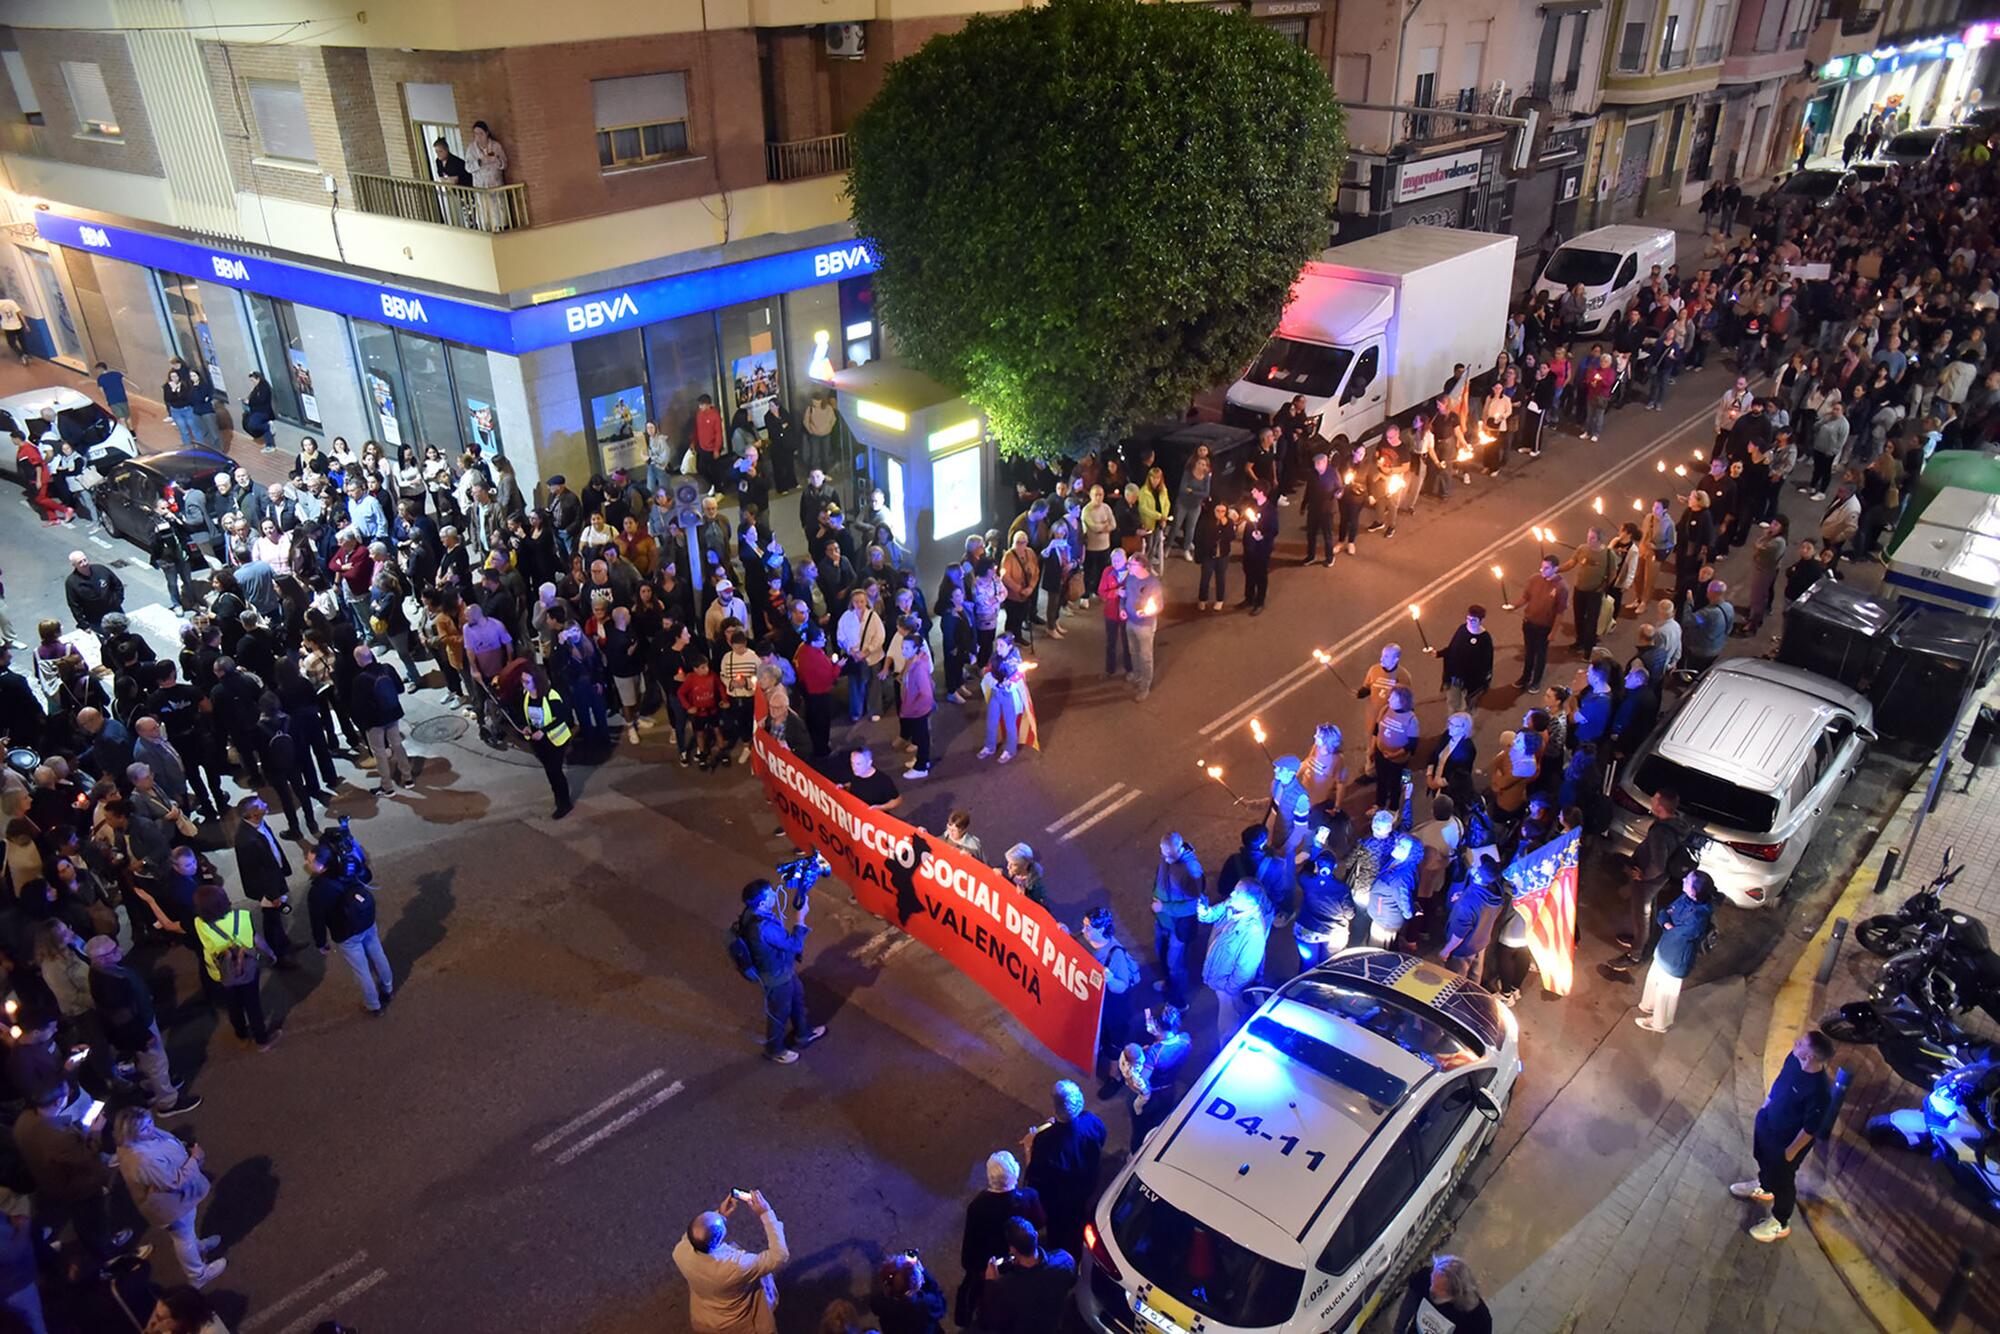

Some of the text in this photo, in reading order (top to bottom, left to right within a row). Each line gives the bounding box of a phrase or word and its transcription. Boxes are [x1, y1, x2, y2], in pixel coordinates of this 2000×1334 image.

[79, 226, 112, 248] BBVA
[212, 256, 250, 281] BBVA
[814, 246, 871, 278] BBVA
[380, 293, 428, 323] BBVA
[565, 292, 639, 333] BBVA
[767, 751, 916, 869] RECONSTRUCCIÓ
[919, 850, 1002, 922] SOCIAL
[1005, 902, 1041, 956] DEL
[1042, 936, 1090, 1001] PAÍS
[924, 893, 1042, 1005] VALENCIÀ
[1205, 1096, 1327, 1172] D4-11
[1138, 1184, 1160, 1203] PLV
[1309, 1278, 1330, 1303] 092
[1319, 1270, 1366, 1320] POLICIA LOCAL
